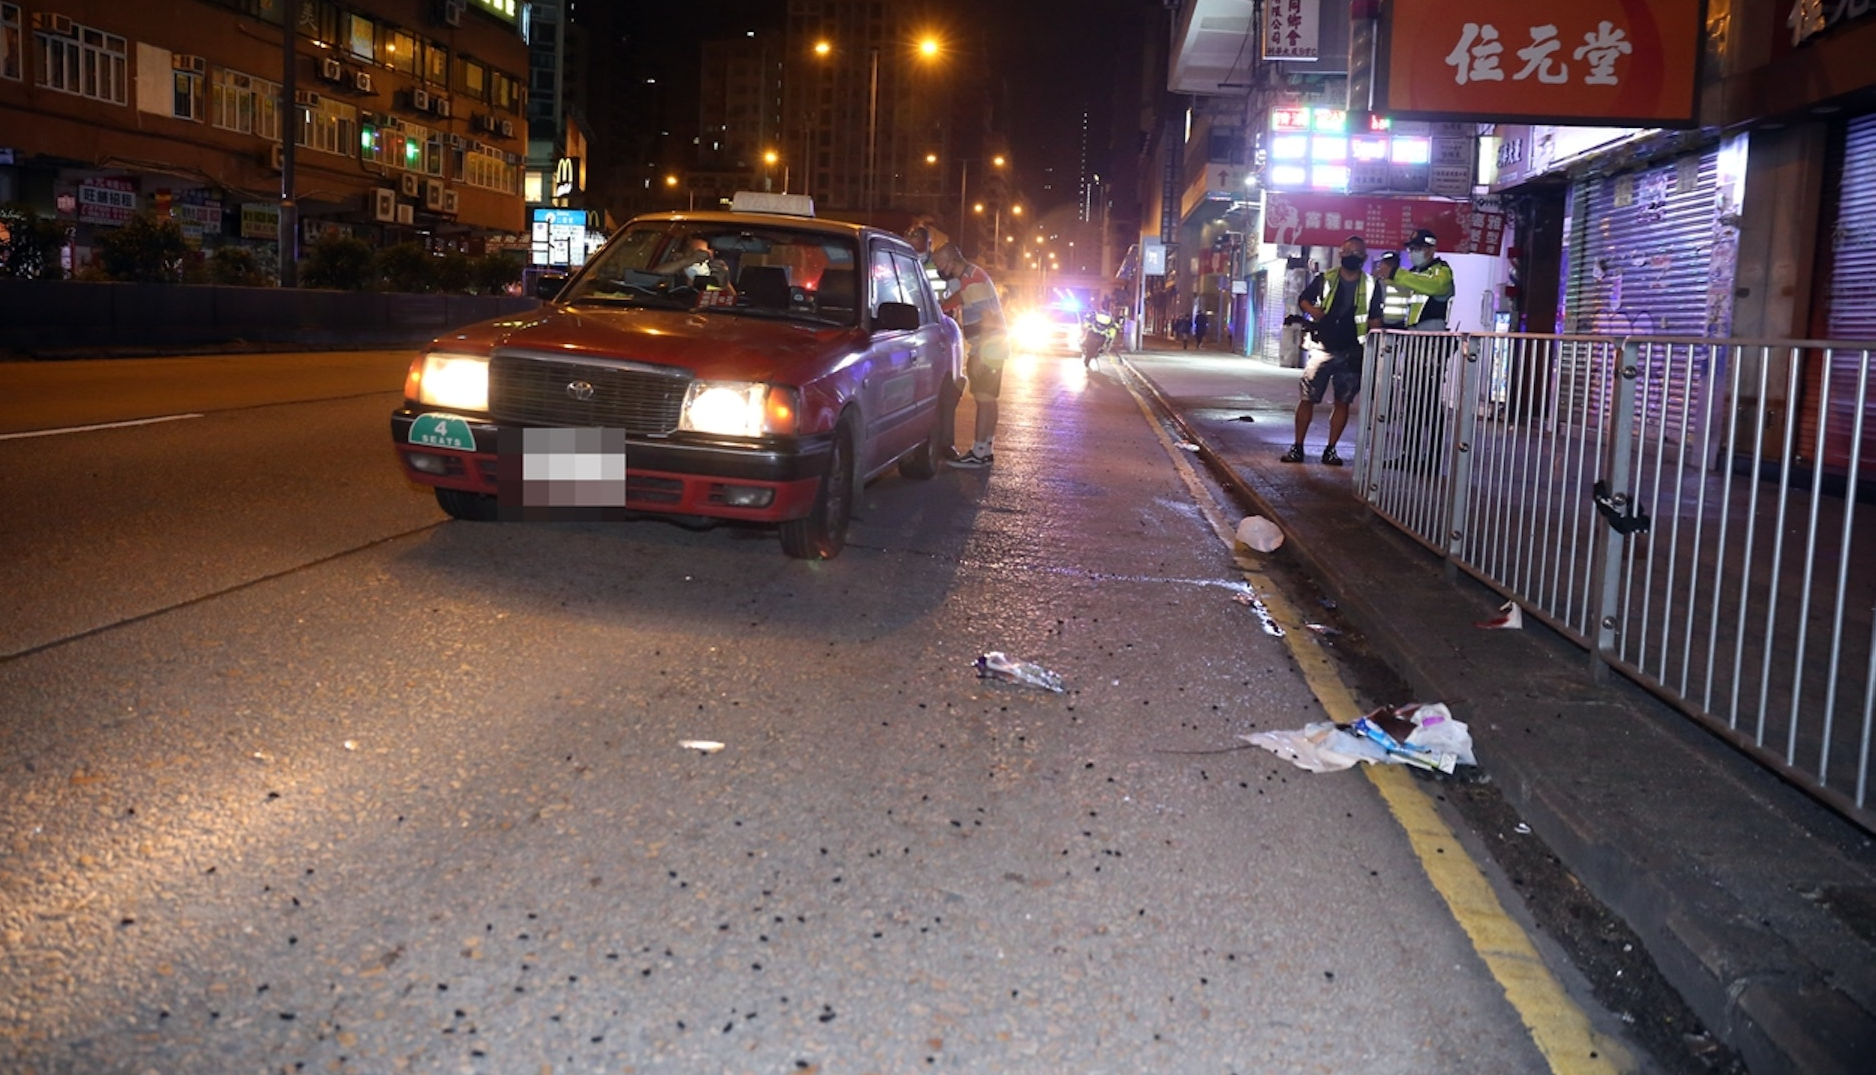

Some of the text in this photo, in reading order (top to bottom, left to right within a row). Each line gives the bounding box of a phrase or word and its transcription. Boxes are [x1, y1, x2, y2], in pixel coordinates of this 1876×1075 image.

[1271, 0, 1282, 44] 限公司
[1445, 20, 1633, 86] 位元堂
[422, 434, 461, 447] SEATS
[434, 421, 447, 436] 4
